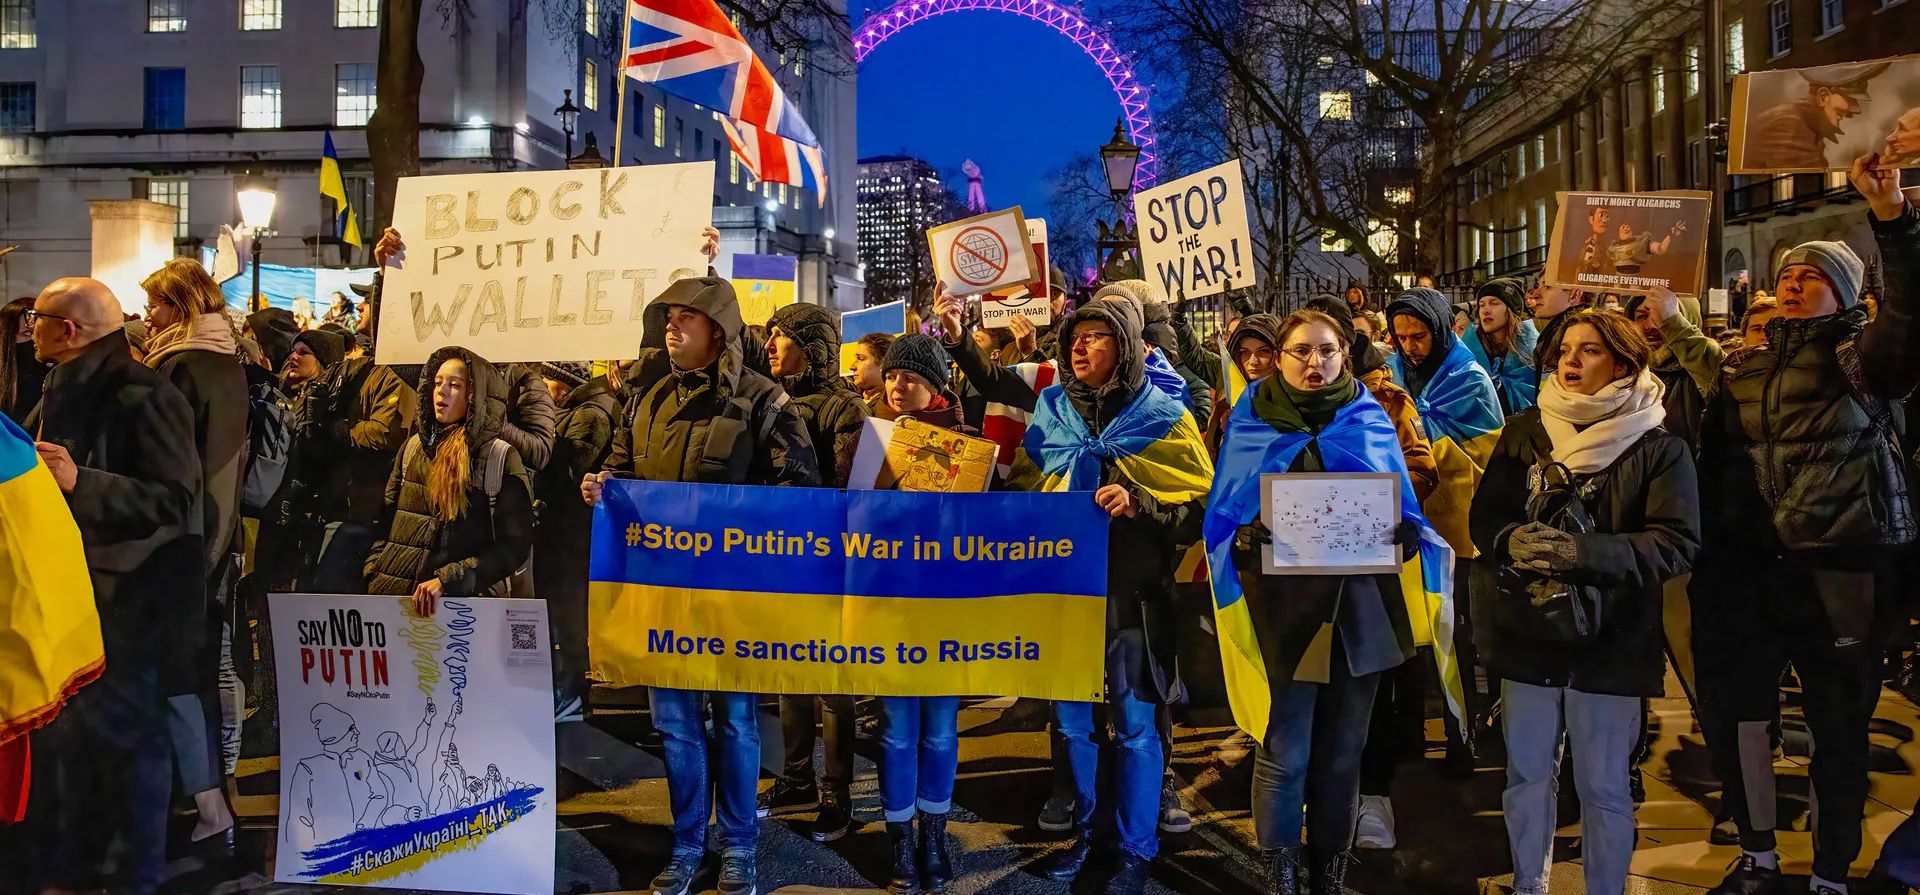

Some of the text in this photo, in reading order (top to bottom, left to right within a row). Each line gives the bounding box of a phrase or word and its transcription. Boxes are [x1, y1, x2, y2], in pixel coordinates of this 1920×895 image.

[424, 169, 628, 240] BLOCK
[1147, 175, 1228, 244] STOP
[1586, 196, 1681, 209] DIRTY MONEY OLIGARCHS
[432, 230, 602, 275] PUTIN
[1178, 233, 1202, 254] THE
[1156, 238, 1242, 299] WAR!
[1577, 272, 1670, 288] OLIGARCHS EVERYWHERE
[409, 267, 699, 344] WALLET
[983, 309, 1005, 319] STOP
[1023, 306, 1047, 317] WAR!
[625, 522, 713, 557] #Stop
[841, 532, 903, 560] War
[913, 535, 941, 560] in
[953, 535, 1074, 562] Ukraine
[297, 608, 387, 648] SAY NO TO
[647, 628, 1040, 665] More sanctions to Russia
[300, 647, 389, 690] PUTIN
